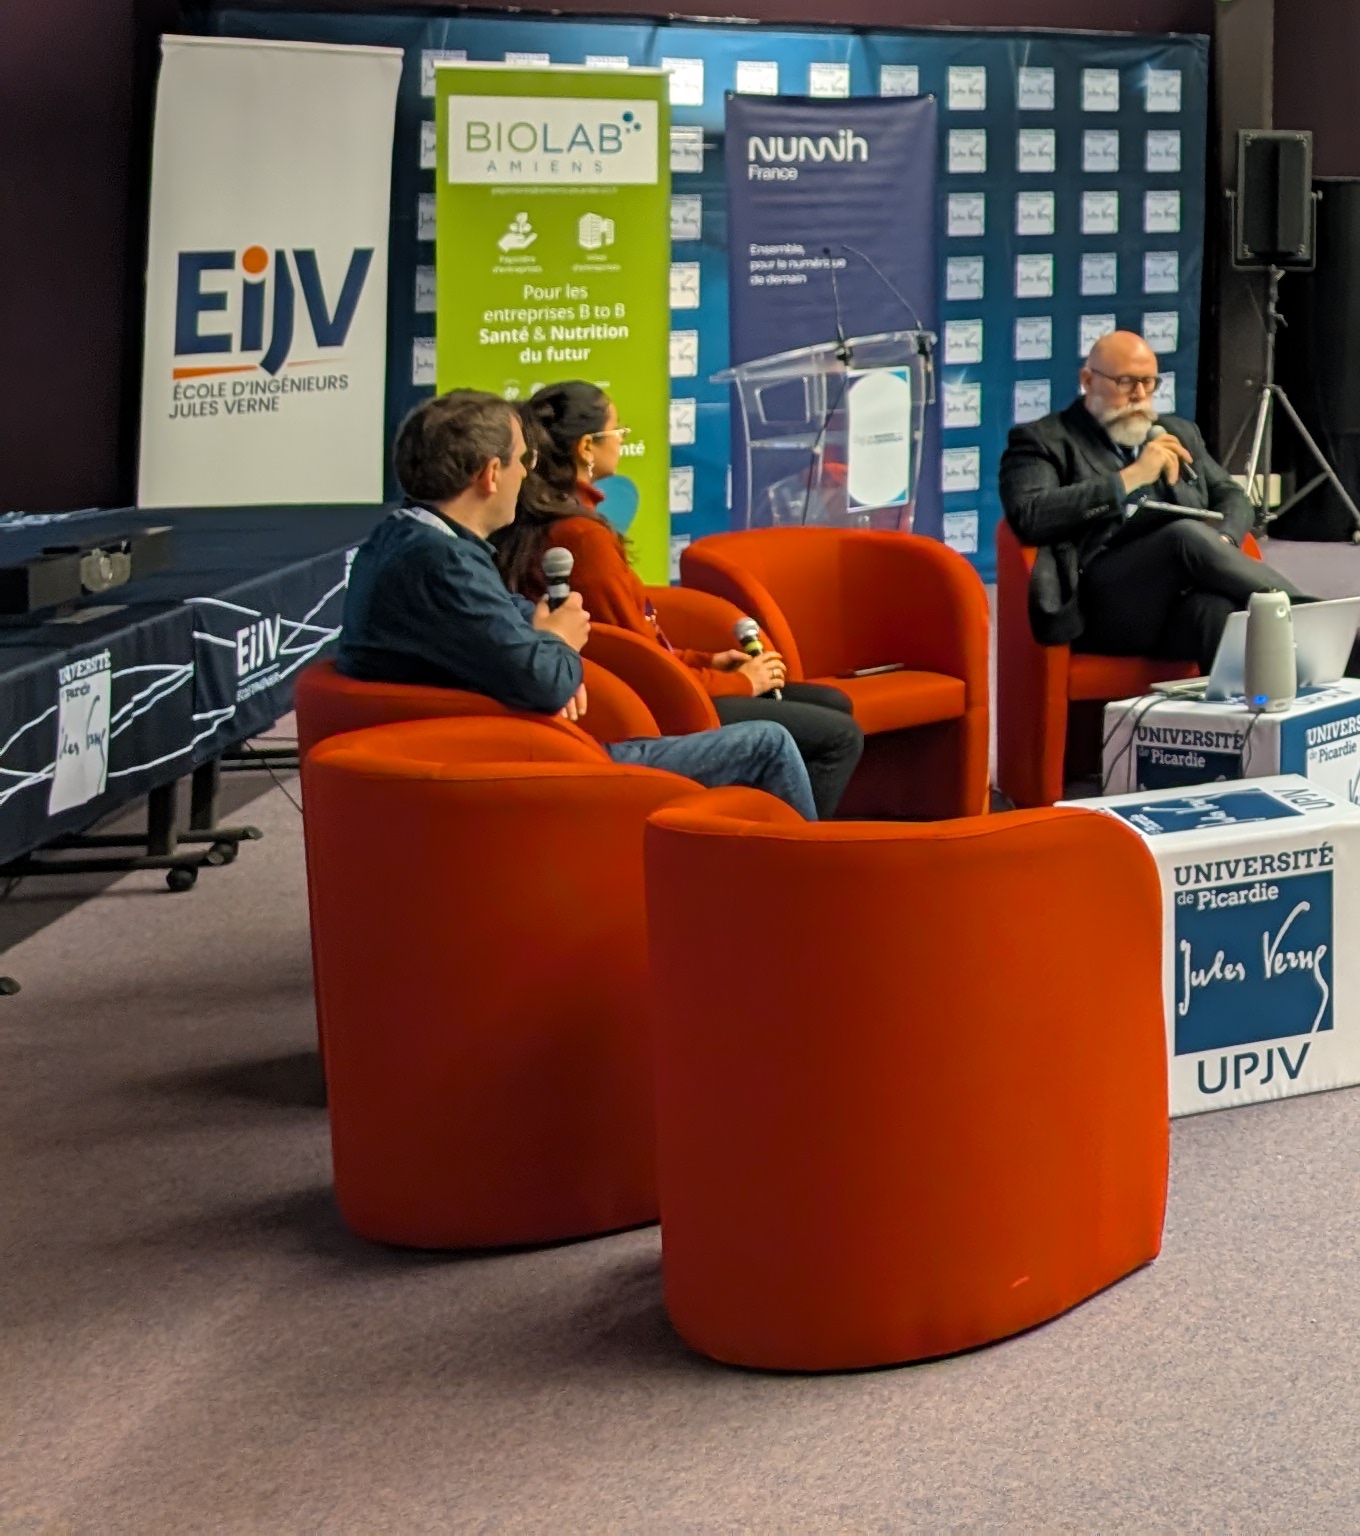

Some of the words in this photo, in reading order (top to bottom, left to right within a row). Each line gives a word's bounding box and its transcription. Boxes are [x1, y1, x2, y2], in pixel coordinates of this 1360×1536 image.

[466, 121, 622, 154] BIOLAB
[487, 160, 603, 173] AMIENS
[748, 164, 798, 181] France
[523, 284, 562, 301] Pour
[566, 283, 588, 300] les
[483, 306, 575, 325] entreprises
[579, 304, 590, 319] B
[593, 305, 610, 319] to
[615, 303, 625, 318] B
[479, 326, 530, 345] Santé
[533, 326, 546, 341] &
[551, 323, 629, 341] Nutrition
[519, 347, 542, 364] du
[547, 346, 591, 362] futur
[173, 382, 226, 401] ÉCOLE
[232, 374, 349, 396] D'INGÉNIEURS
[169, 400, 218, 419] JULES
[225, 396, 280, 414] VERNE
[1136, 725, 1244, 751] UNIVERSITÉ
[1151, 749, 1206, 768] Picardie
[1318, 740, 1357, 763] Picardie
[1174, 842, 1335, 887] UNIVERSITÉ
[1177, 889, 1194, 906] de
[1196, 882, 1279, 912] Picardie
[1178, 940, 1246, 1016] Jules
[1197, 1042, 1311, 1095] UPJV
